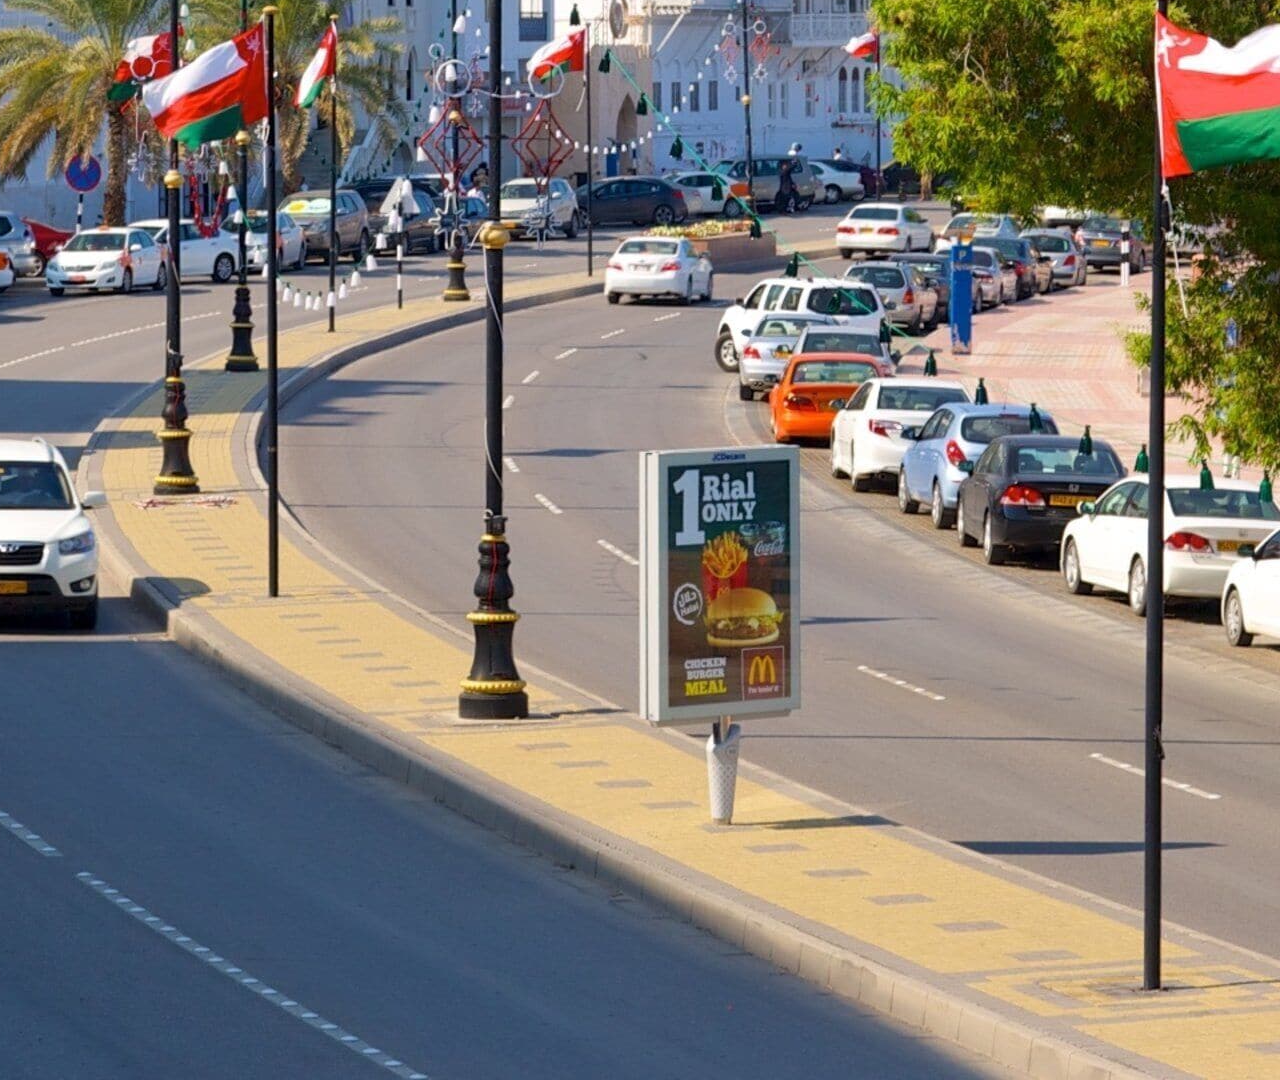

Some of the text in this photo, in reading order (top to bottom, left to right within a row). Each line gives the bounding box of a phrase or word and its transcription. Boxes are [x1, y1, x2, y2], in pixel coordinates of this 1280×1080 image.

[673, 469, 756, 547] 1 Rial
[702, 501, 757, 523] ONLY
[684, 657, 727, 669] CHICKEN
[686, 667, 725, 680] BURGER
[685, 679, 727, 697] MEAL
